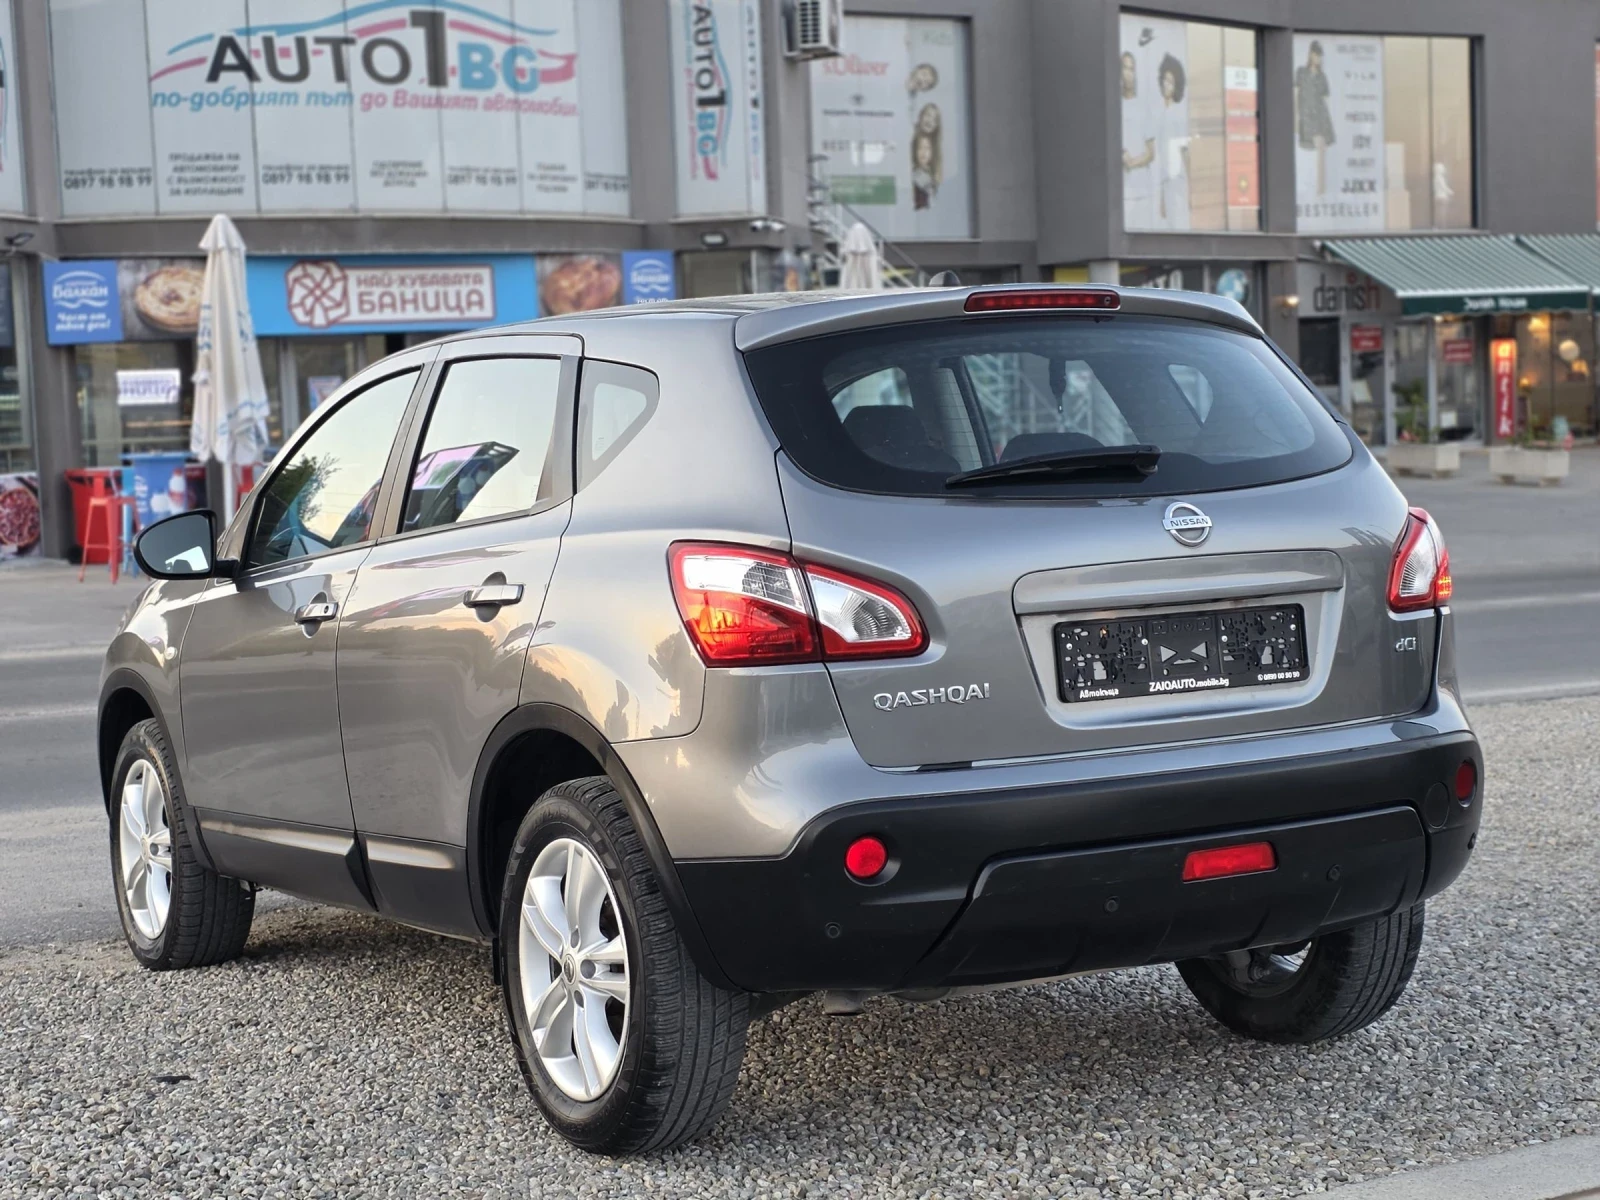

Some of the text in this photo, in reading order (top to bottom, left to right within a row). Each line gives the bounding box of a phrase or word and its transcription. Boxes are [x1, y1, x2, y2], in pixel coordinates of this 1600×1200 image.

[360, 91, 387, 112] до
[356, 272, 485, 288] НАЙ-ХУБАВАТА
[1313, 272, 1381, 312] danish
[357, 289, 485, 316] БАНИЦА
[1170, 517, 1208, 527] NISSAN
[873, 682, 990, 712] QASHQAI
